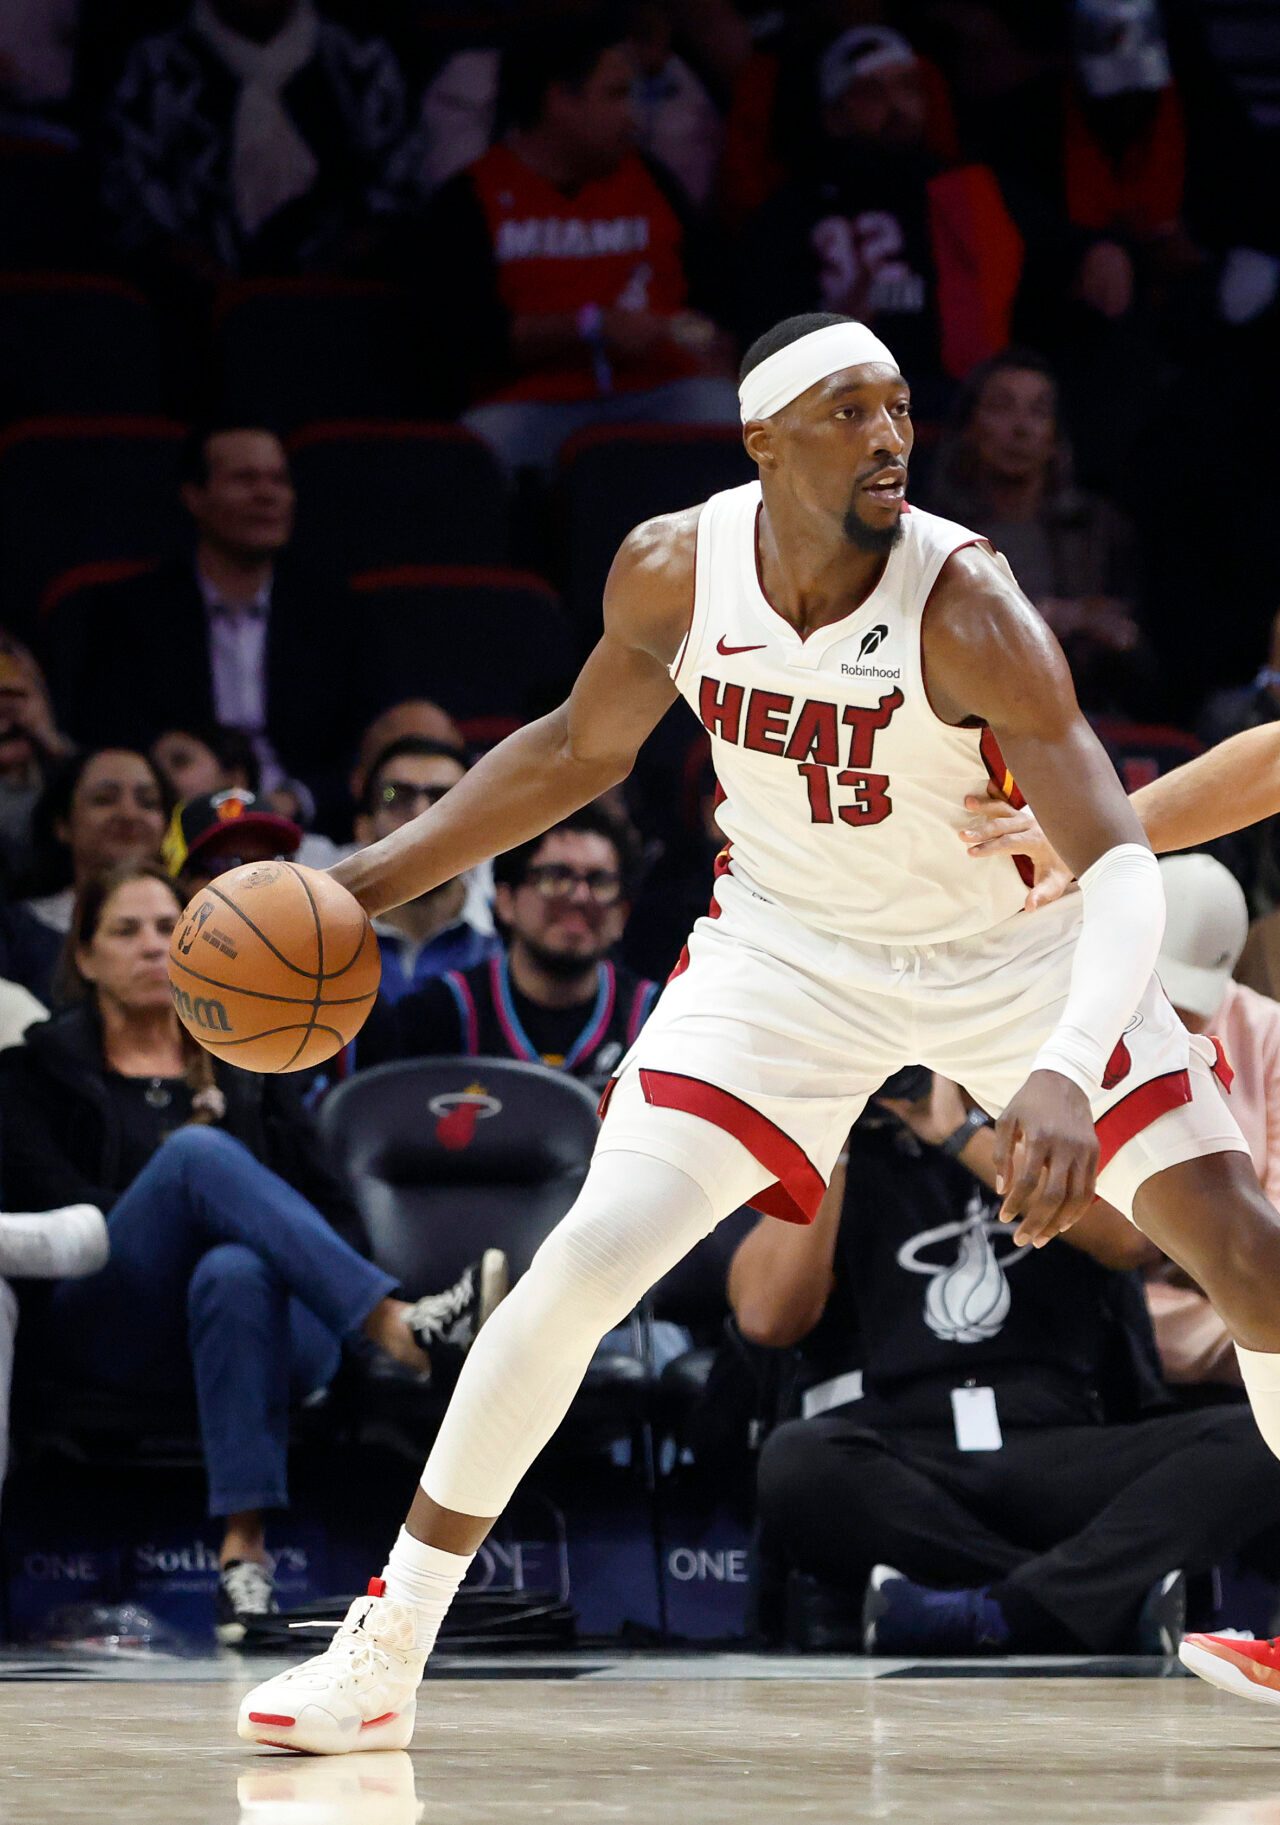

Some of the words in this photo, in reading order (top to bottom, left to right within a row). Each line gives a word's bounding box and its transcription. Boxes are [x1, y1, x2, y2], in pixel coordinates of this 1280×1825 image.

[496, 215, 652, 264] MIAMI
[841, 663, 900, 679] Robinhood
[699, 675, 905, 768] HEAT
[797, 762, 893, 827] 13
[668, 1547, 750, 1583] ONE
